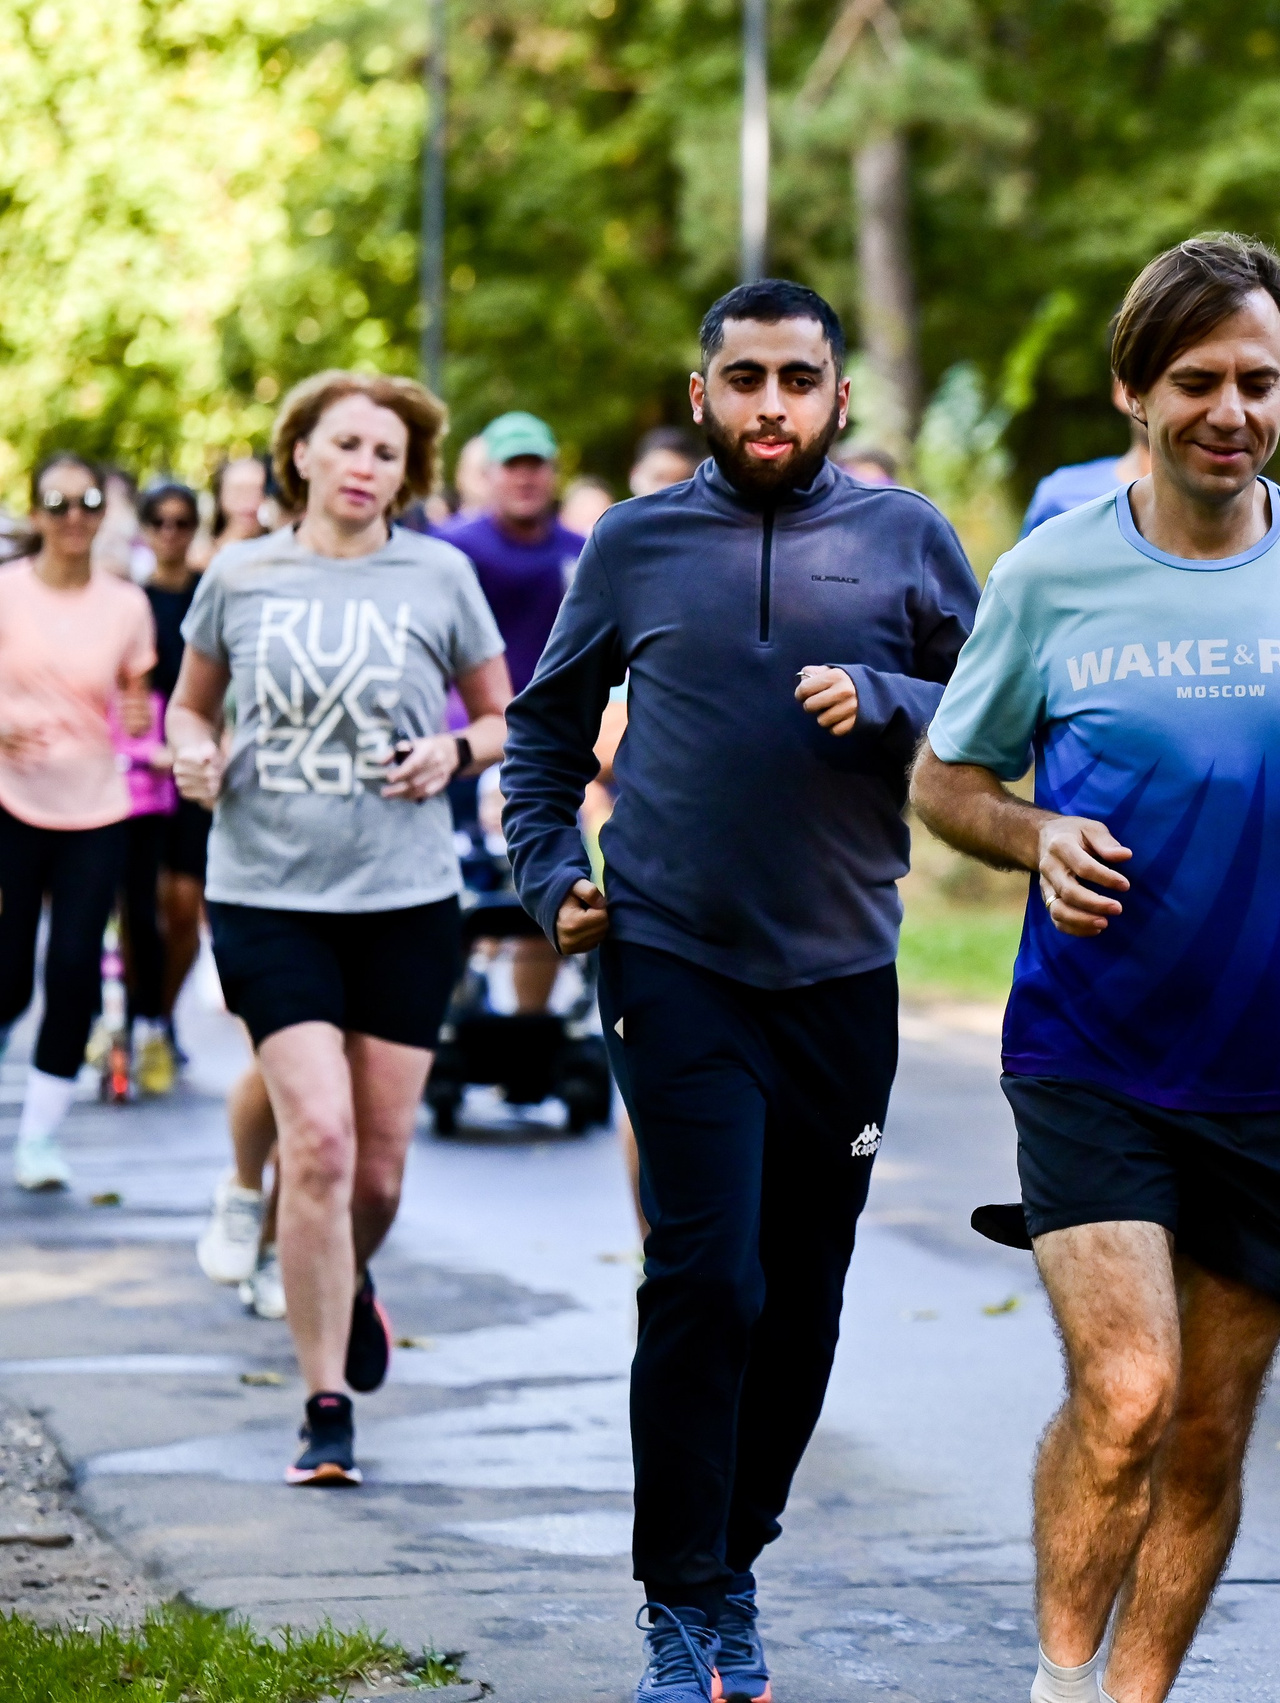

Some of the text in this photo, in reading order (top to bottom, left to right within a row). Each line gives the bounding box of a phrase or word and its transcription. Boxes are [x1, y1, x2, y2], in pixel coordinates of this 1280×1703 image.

[256, 597, 411, 669] RUN
[255, 666, 402, 732] NYC
[1176, 684, 1266, 699] MOSCOW
